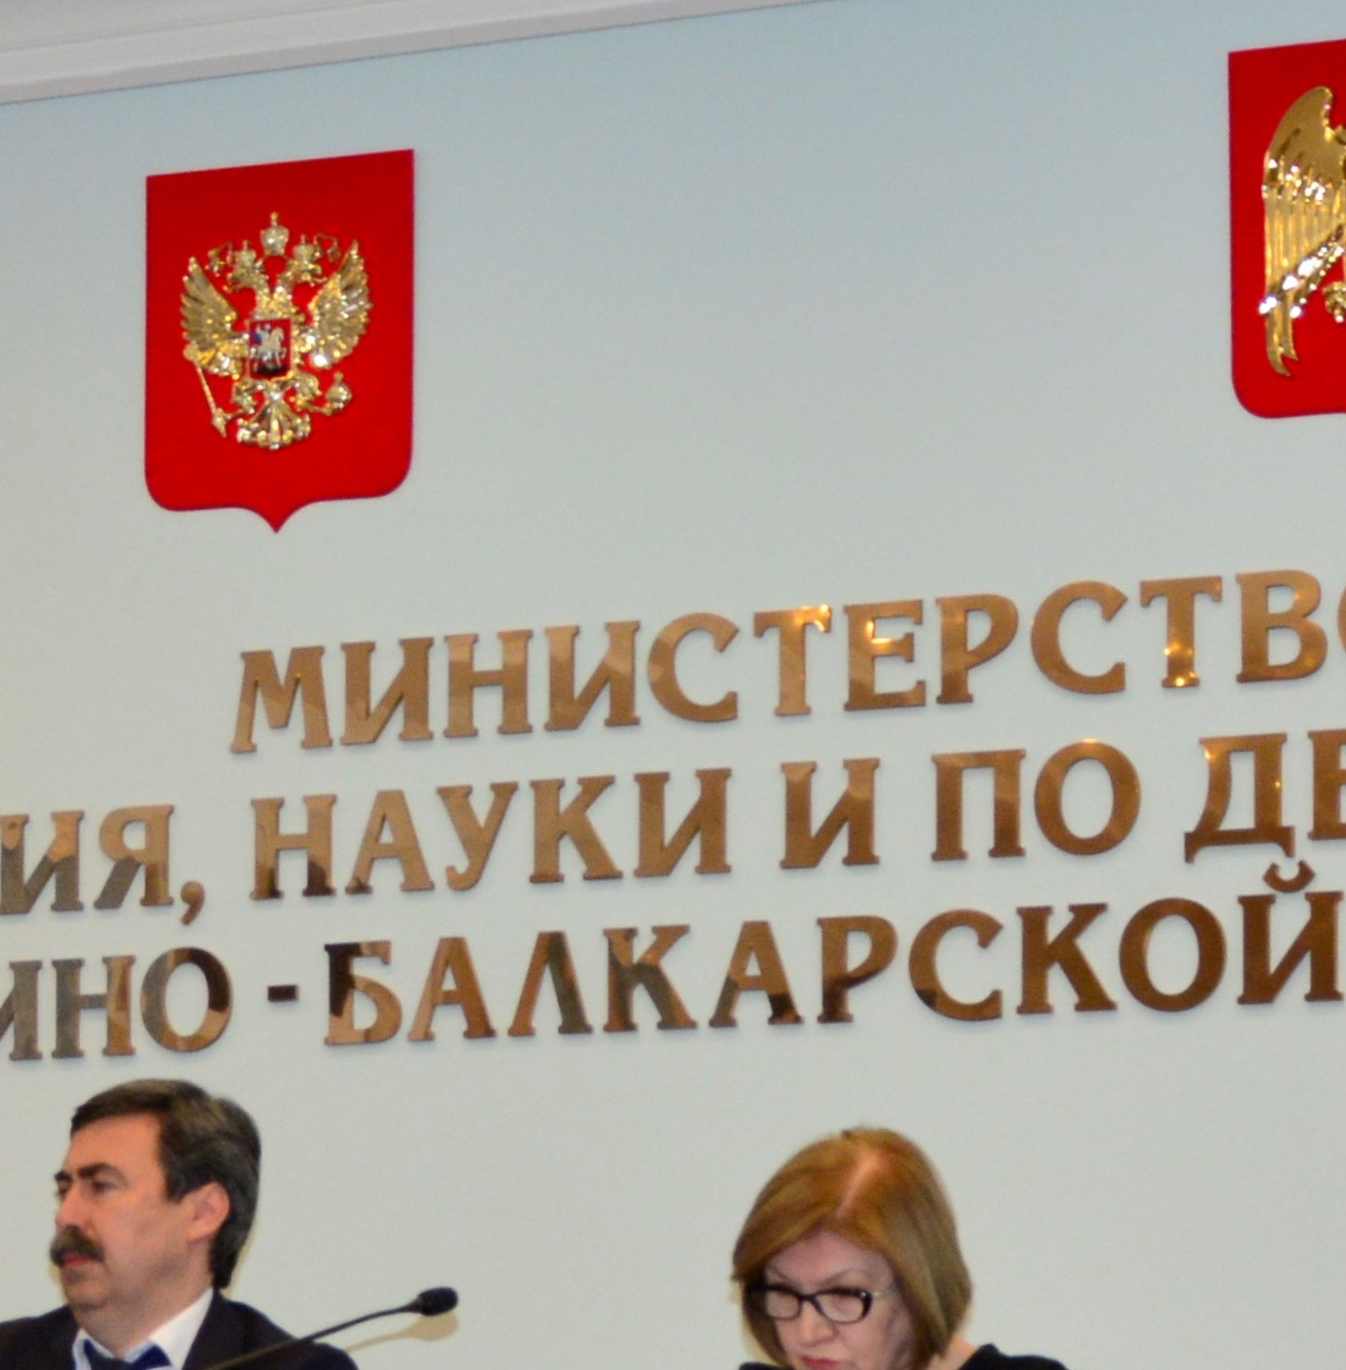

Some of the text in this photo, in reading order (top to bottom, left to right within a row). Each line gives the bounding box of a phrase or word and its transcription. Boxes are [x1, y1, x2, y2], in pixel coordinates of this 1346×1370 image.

[231, 569, 1346, 752] МИНИСТЕРСТВ
[250, 767, 732, 901] НАУКИ
[779, 757, 881, 870] И
[931, 739, 1142, 861] ПО
